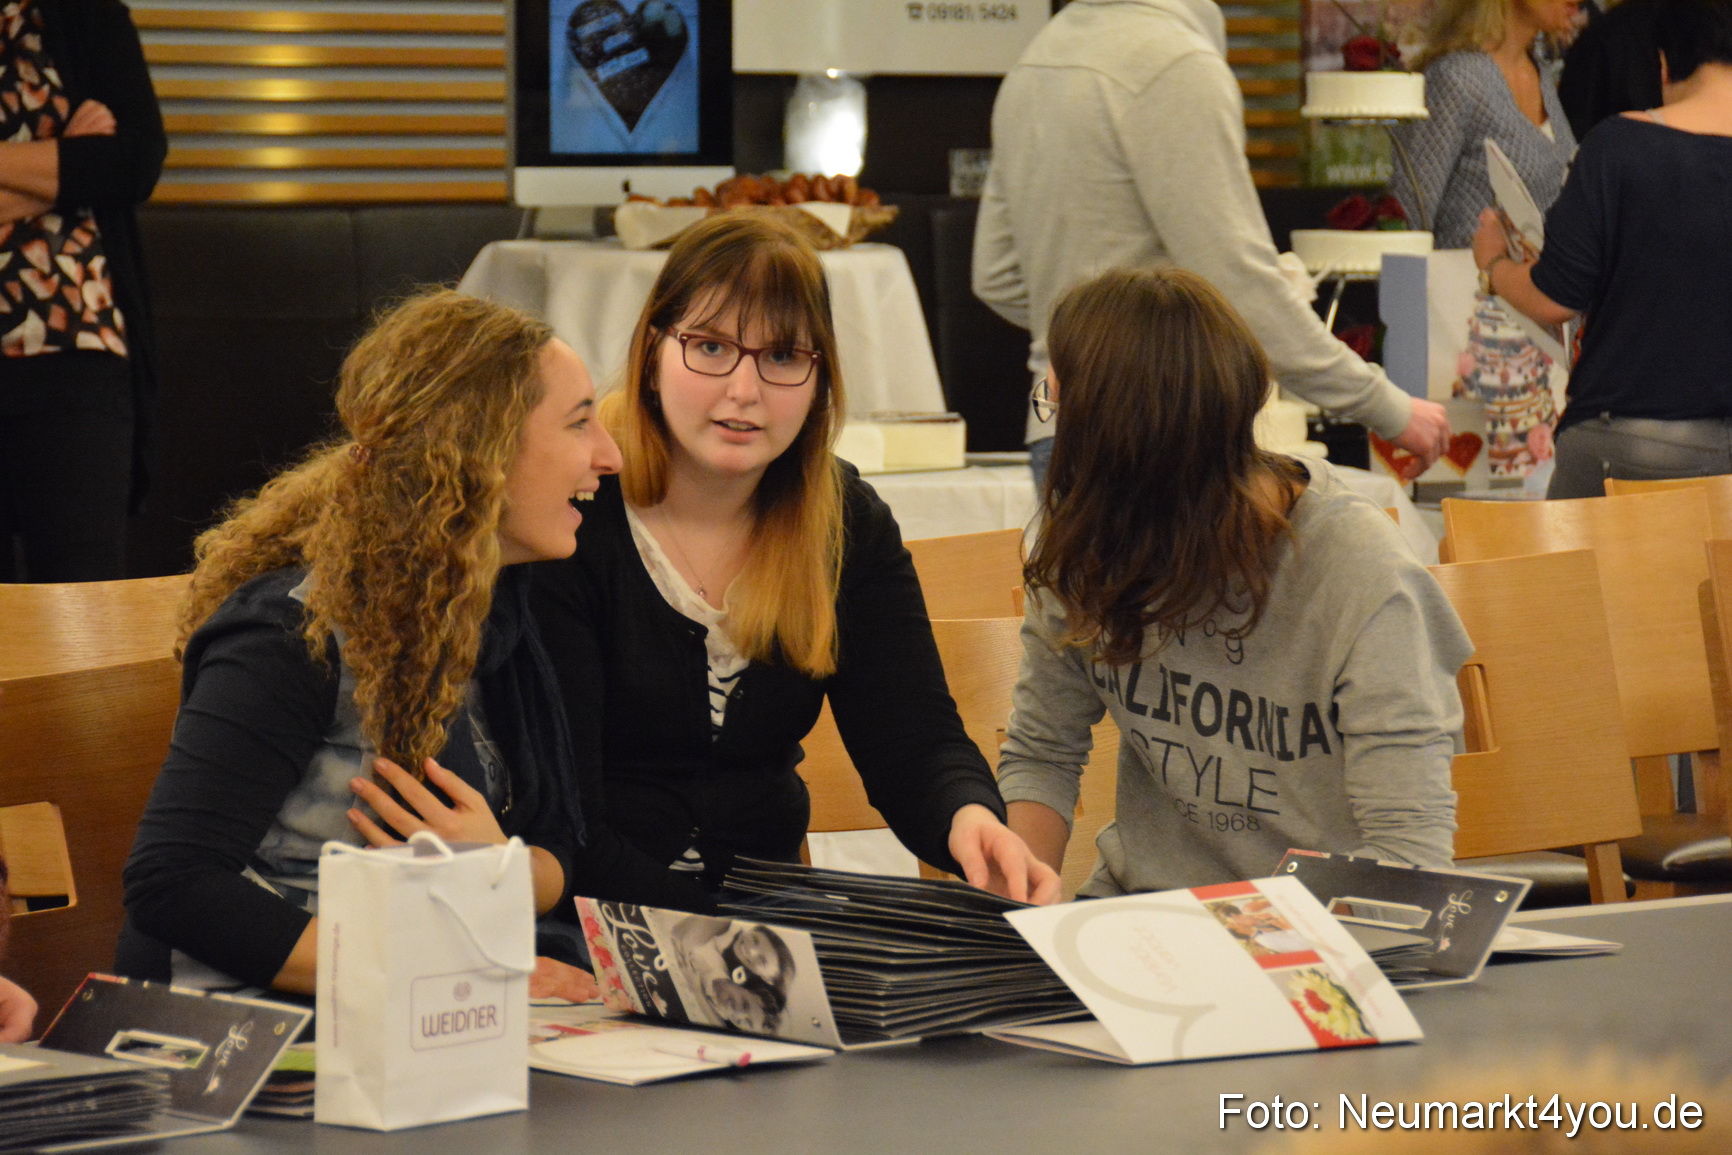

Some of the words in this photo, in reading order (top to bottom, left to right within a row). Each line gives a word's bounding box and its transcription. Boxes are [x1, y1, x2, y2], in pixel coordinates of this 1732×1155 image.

[1091, 660, 1332, 762] CALIFORNIA
[1130, 727, 1280, 815] STYLE
[1207, 812, 1261, 833] 1968
[421, 1004, 497, 1038] WEIDNER
